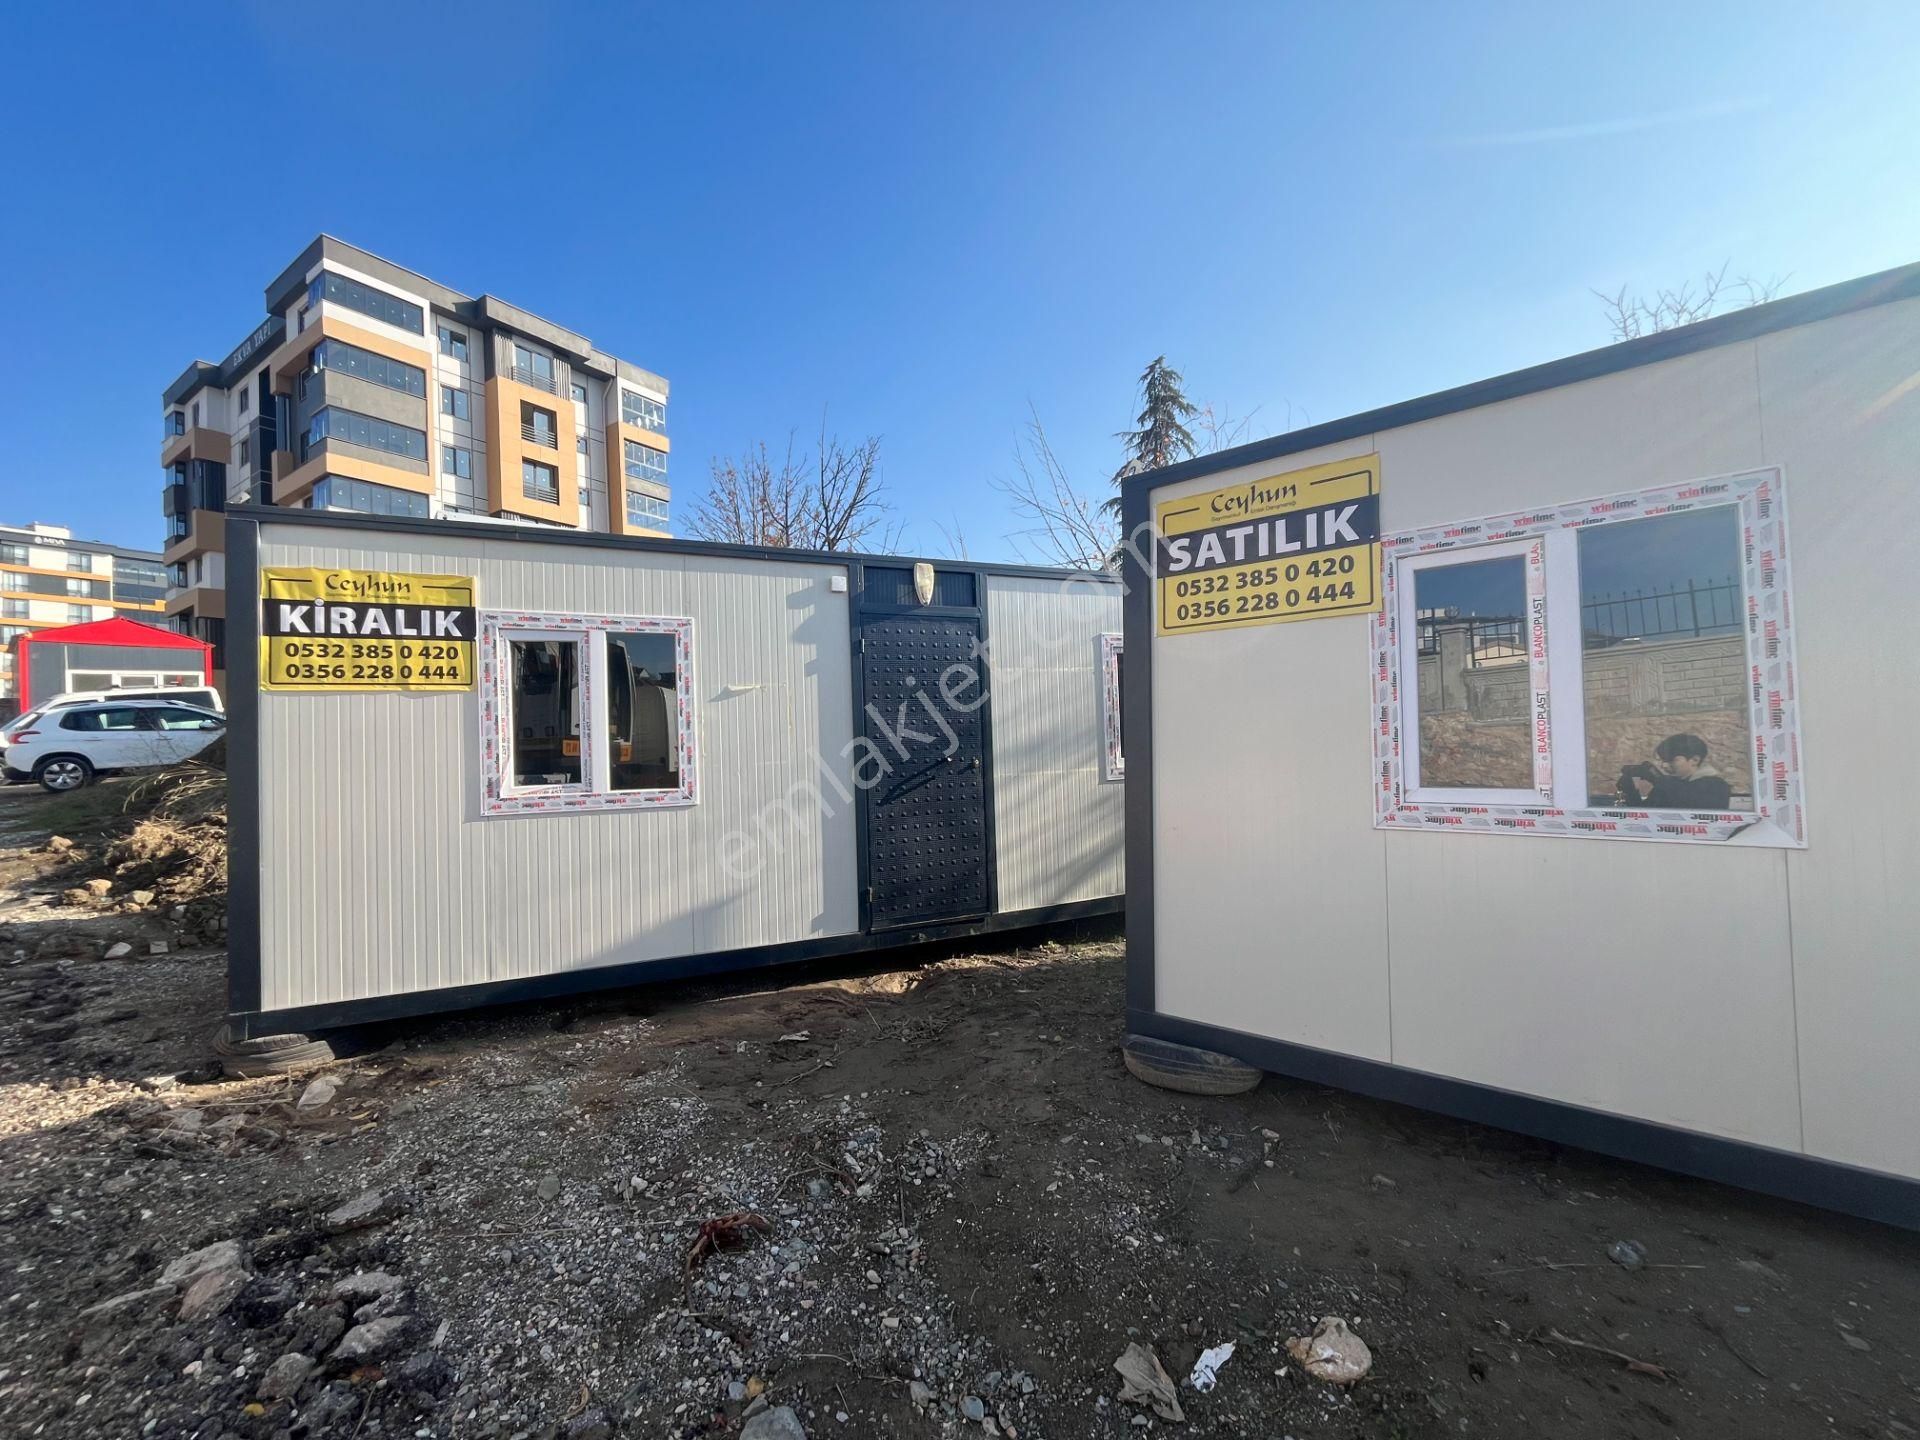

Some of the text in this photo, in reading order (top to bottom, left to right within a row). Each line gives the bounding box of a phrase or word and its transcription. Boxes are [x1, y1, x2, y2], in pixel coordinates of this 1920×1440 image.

[1210, 482, 1297, 515] Ceyhun
[1168, 504, 1360, 572] SATILIK
[325, 574, 411, 598] Ceyhun
[1176, 575, 1230, 598] 0532
[1235, 567, 1278, 590] 385
[1285, 564, 1300, 582] 0
[1306, 554, 1355, 577] 420
[279, 598, 463, 637] KİRALIK
[1177, 581, 1355, 621] 0356 228 0 444
[1533, 598, 1544, 658] BLANCOPLAST
[284, 643, 459, 660] 0532 385 0 420
[285, 664, 459, 680] 0356 228 0 444
[1537, 692, 1547, 753] BLANCOPLAST
